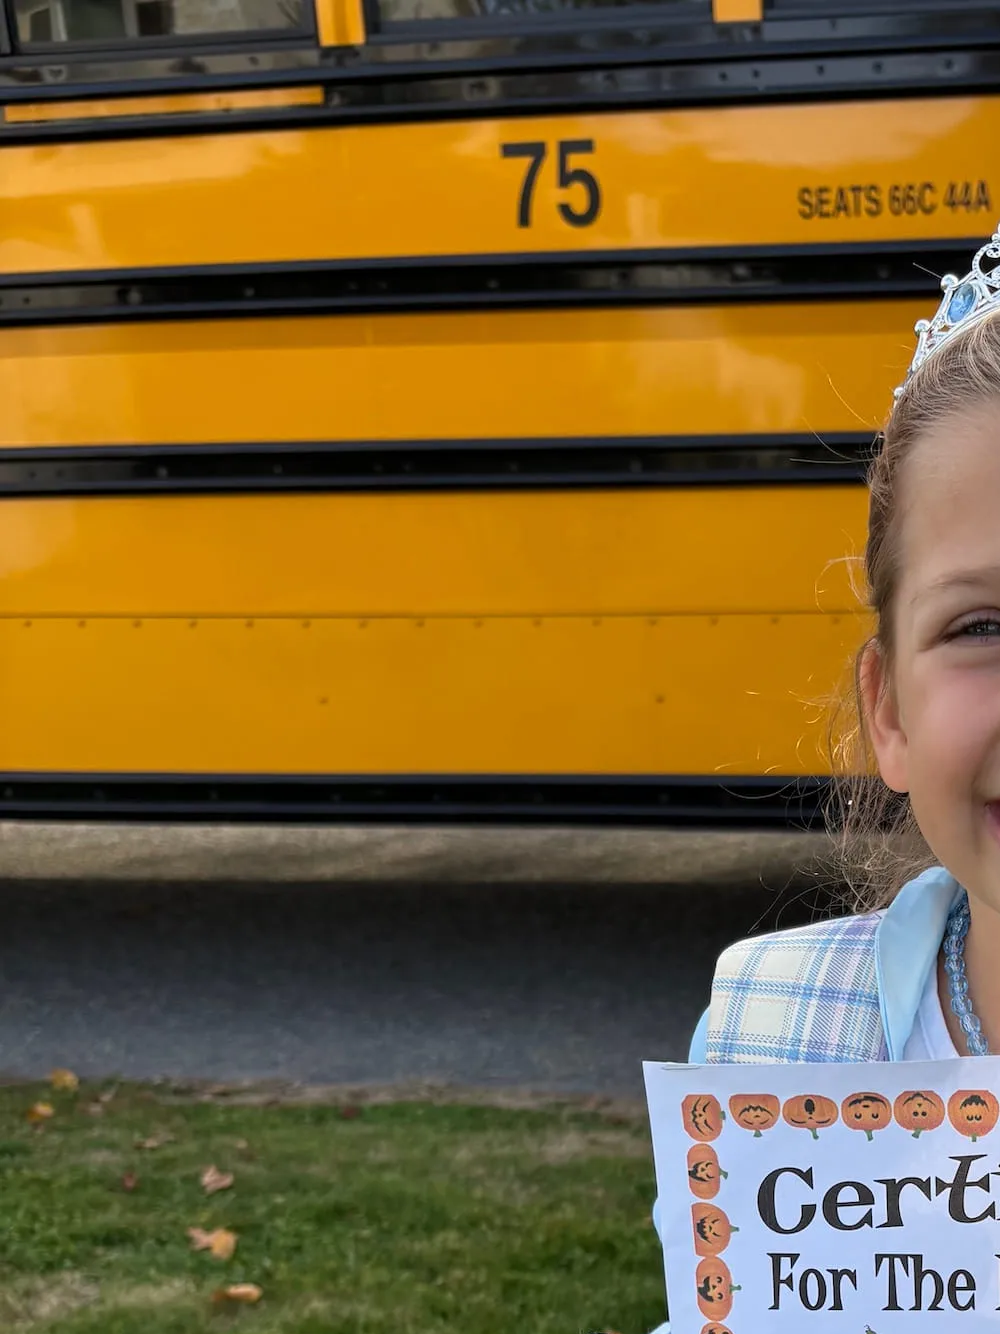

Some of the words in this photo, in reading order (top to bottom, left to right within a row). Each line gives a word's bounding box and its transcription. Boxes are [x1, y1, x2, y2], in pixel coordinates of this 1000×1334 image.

[501, 139, 601, 228] 75
[798, 185, 882, 220] SEATS
[888, 182, 937, 216] 66C
[944, 180, 992, 213] 44A
[767, 1253, 857, 1310] For
[875, 1254, 976, 1311] The
